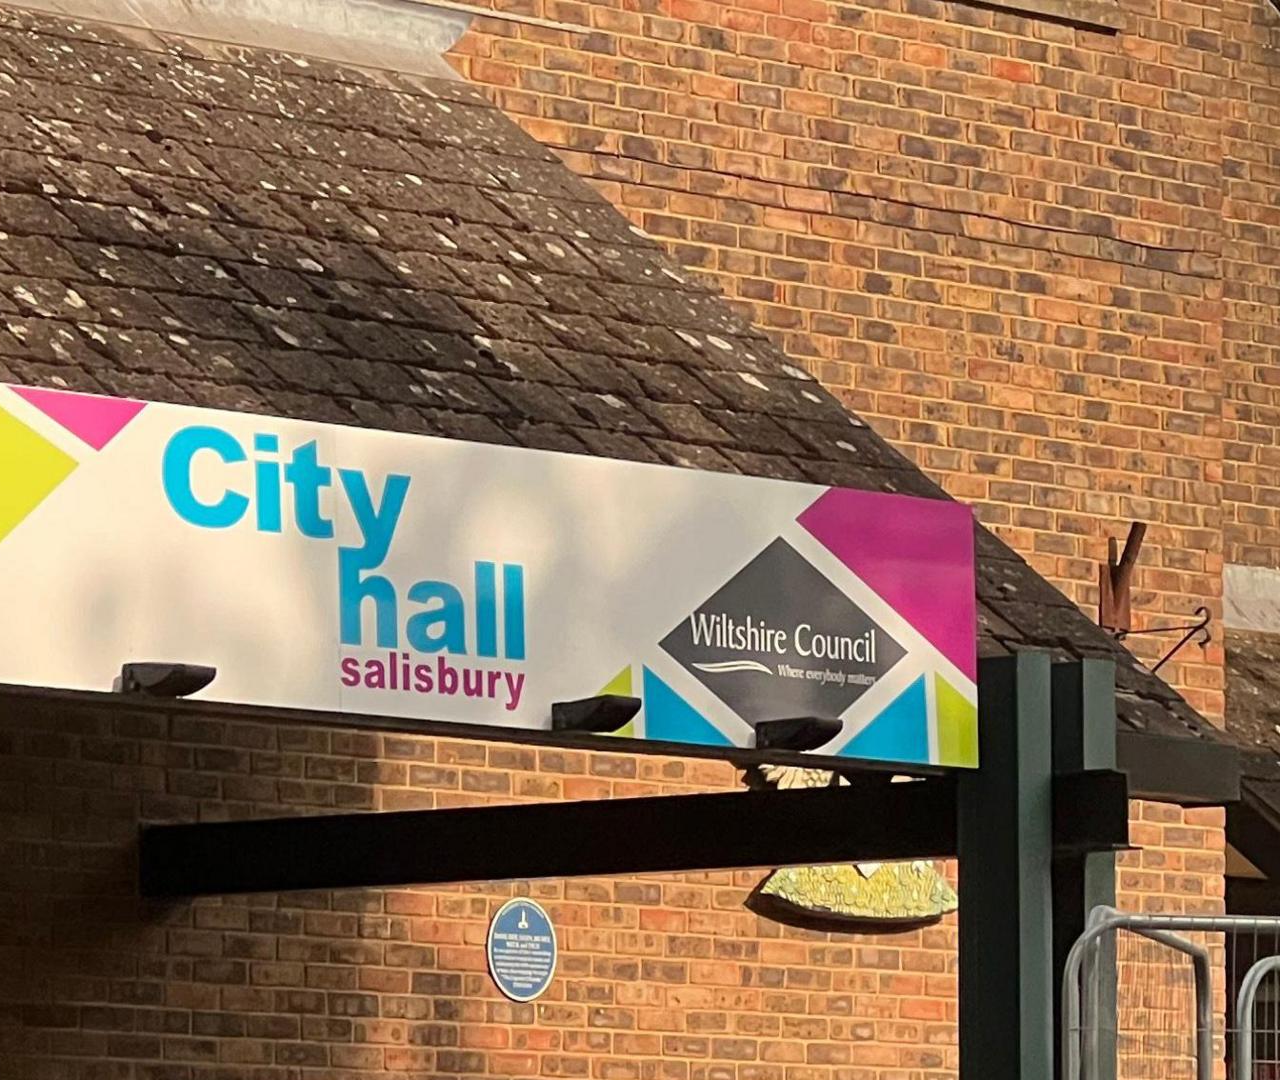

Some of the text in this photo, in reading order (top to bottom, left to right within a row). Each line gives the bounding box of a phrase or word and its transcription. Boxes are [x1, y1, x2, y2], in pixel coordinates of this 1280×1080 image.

[163, 425, 411, 570] City
[338, 546, 526, 661] hall
[689, 613, 876, 664] Wiltshire Council
[341, 652, 526, 711] salisbury
[777, 664, 804, 679] Where
[806, 668, 846, 687] everybody
